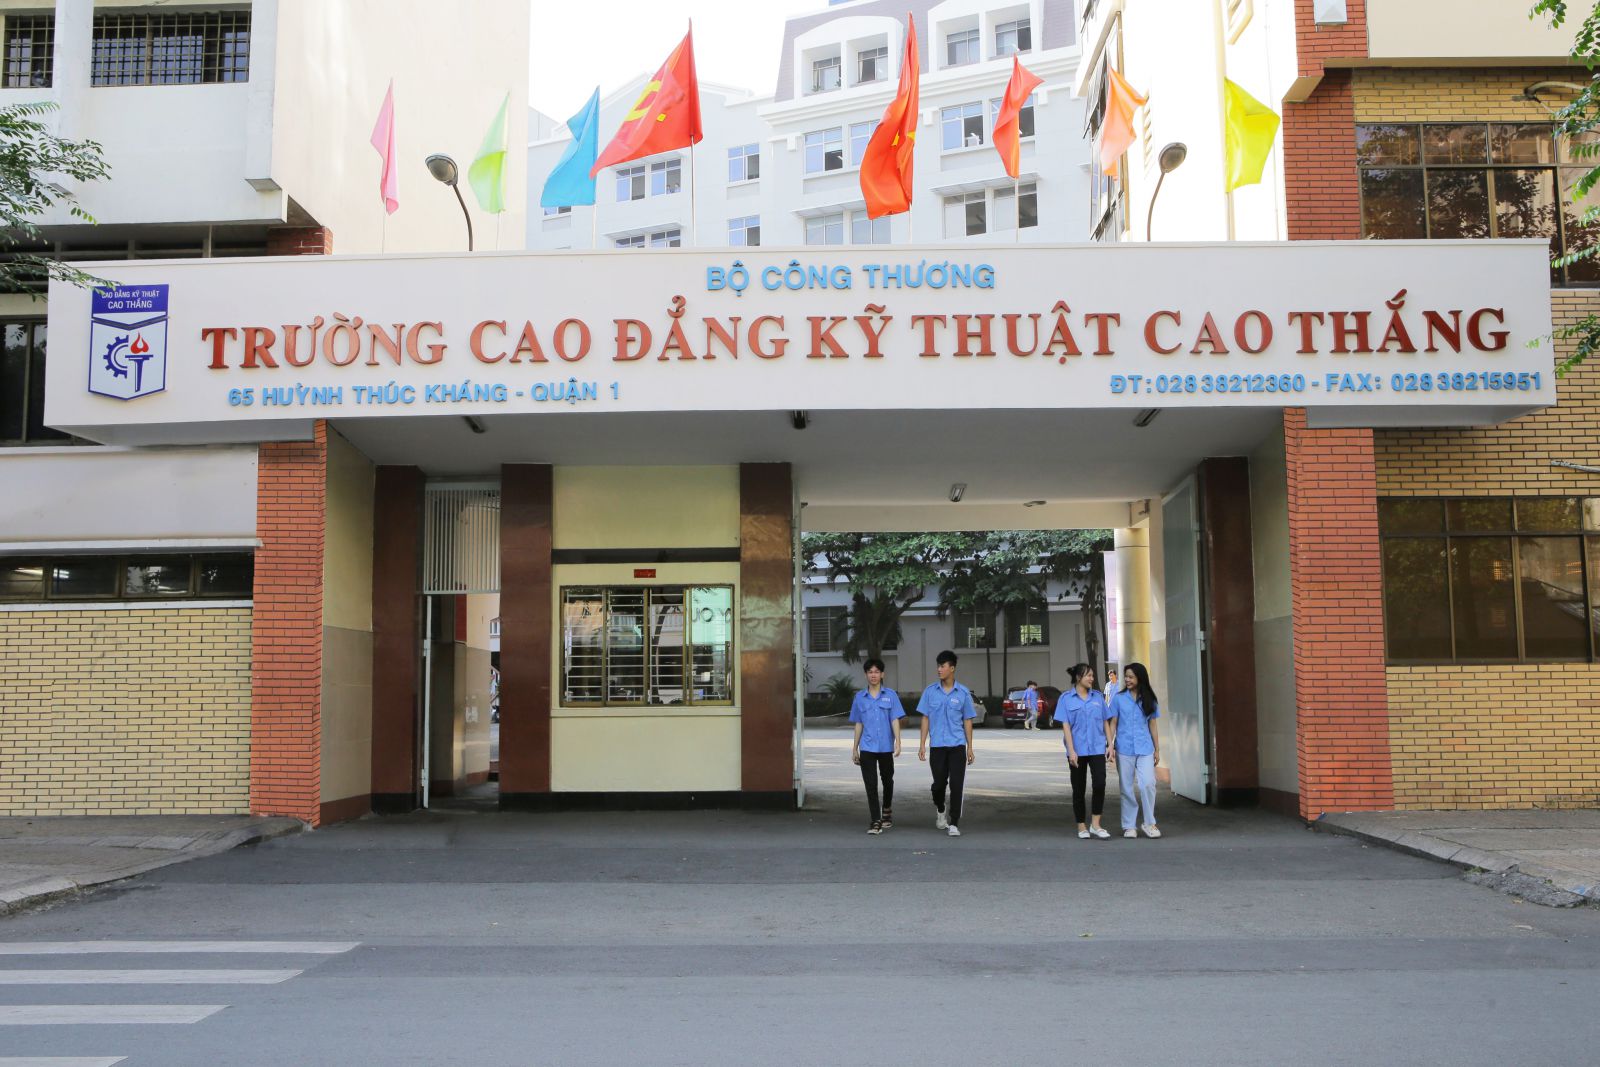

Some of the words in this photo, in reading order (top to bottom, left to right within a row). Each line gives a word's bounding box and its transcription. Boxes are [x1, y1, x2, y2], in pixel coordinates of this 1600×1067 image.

[707, 258, 749, 296] BỘ
[762, 258, 852, 290] CÔNG
[862, 258, 996, 289] THƯƠNG
[108, 301, 123, 310] CAO
[201, 311, 448, 370] TRƯỜNG
[470, 319, 591, 364] CAO
[806, 303, 893, 359] KỸ
[911, 300, 1121, 365] THUẬT
[1144, 310, 1274, 355] CAO
[1288, 288, 1511, 354] THẮNG
[228, 387, 255, 406] 65
[351, 380, 416, 404] THÚC
[425, 379, 508, 402] KHÁNG
[530, 376, 598, 404] QUẬN
[609, 382, 619, 400] 1
[1325, 372, 1382, 391] FAX:
